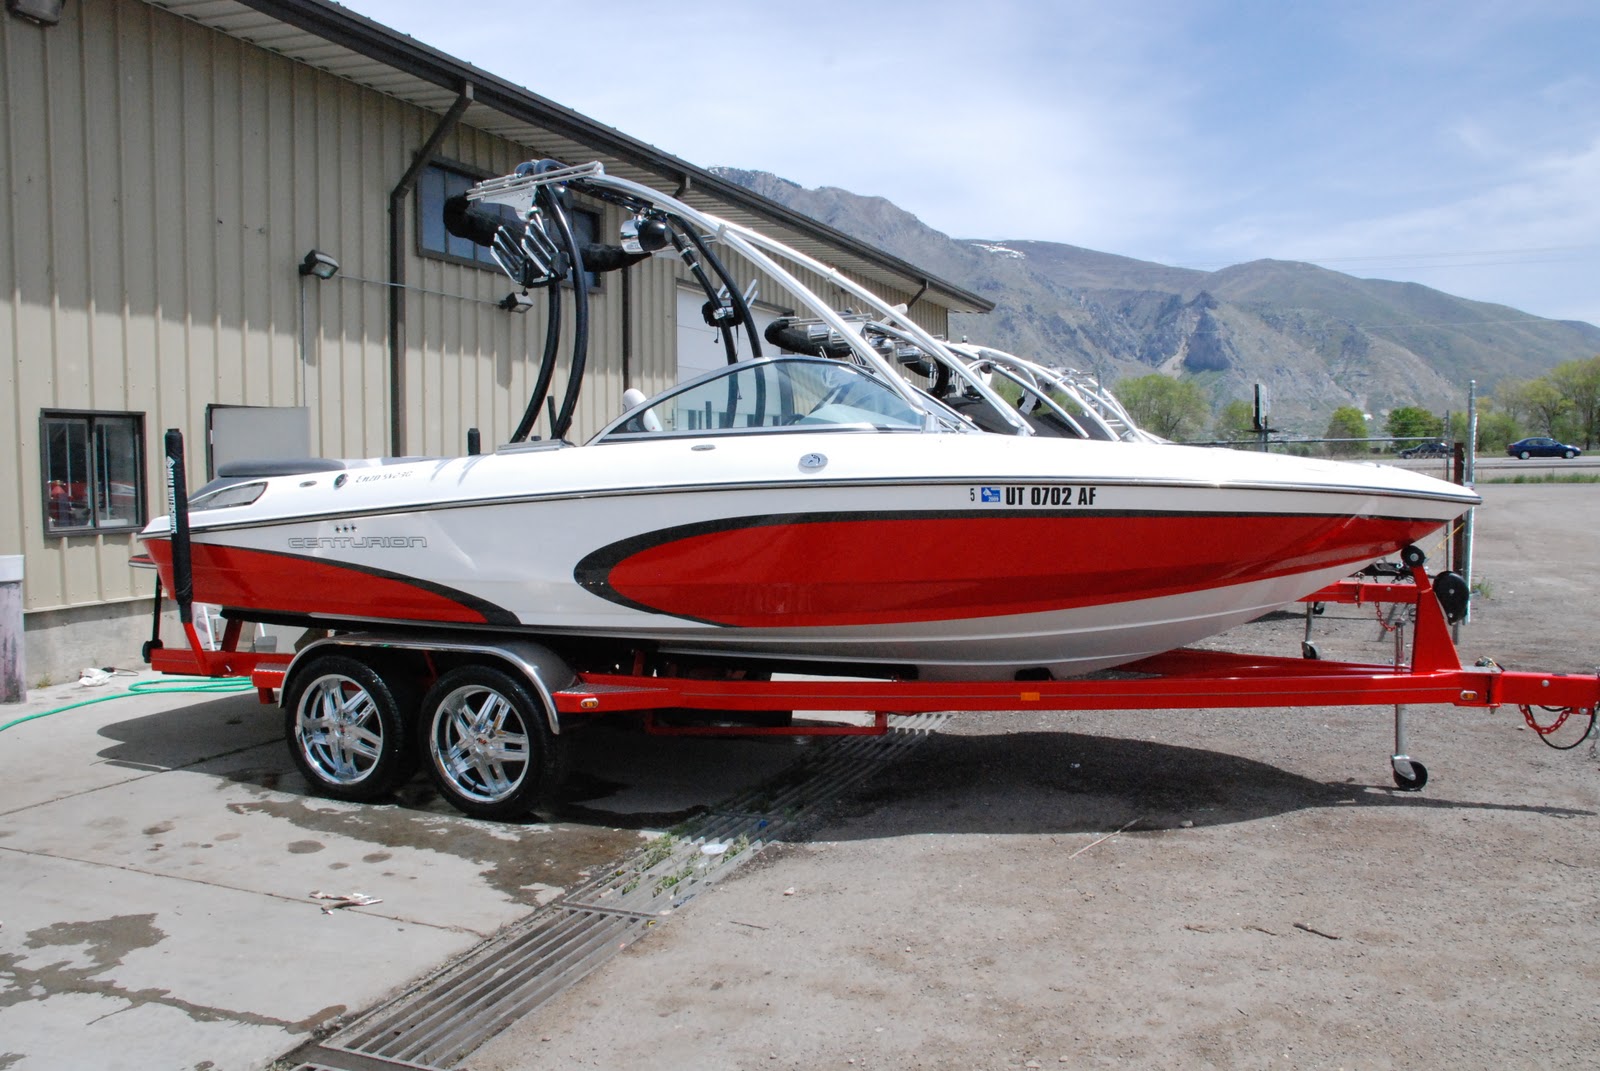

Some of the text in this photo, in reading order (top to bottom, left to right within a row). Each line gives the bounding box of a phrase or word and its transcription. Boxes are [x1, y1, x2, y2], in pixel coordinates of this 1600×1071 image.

[970, 487, 1096, 505] 5 UT 0702 AF
[288, 536, 427, 548] CENTURION
